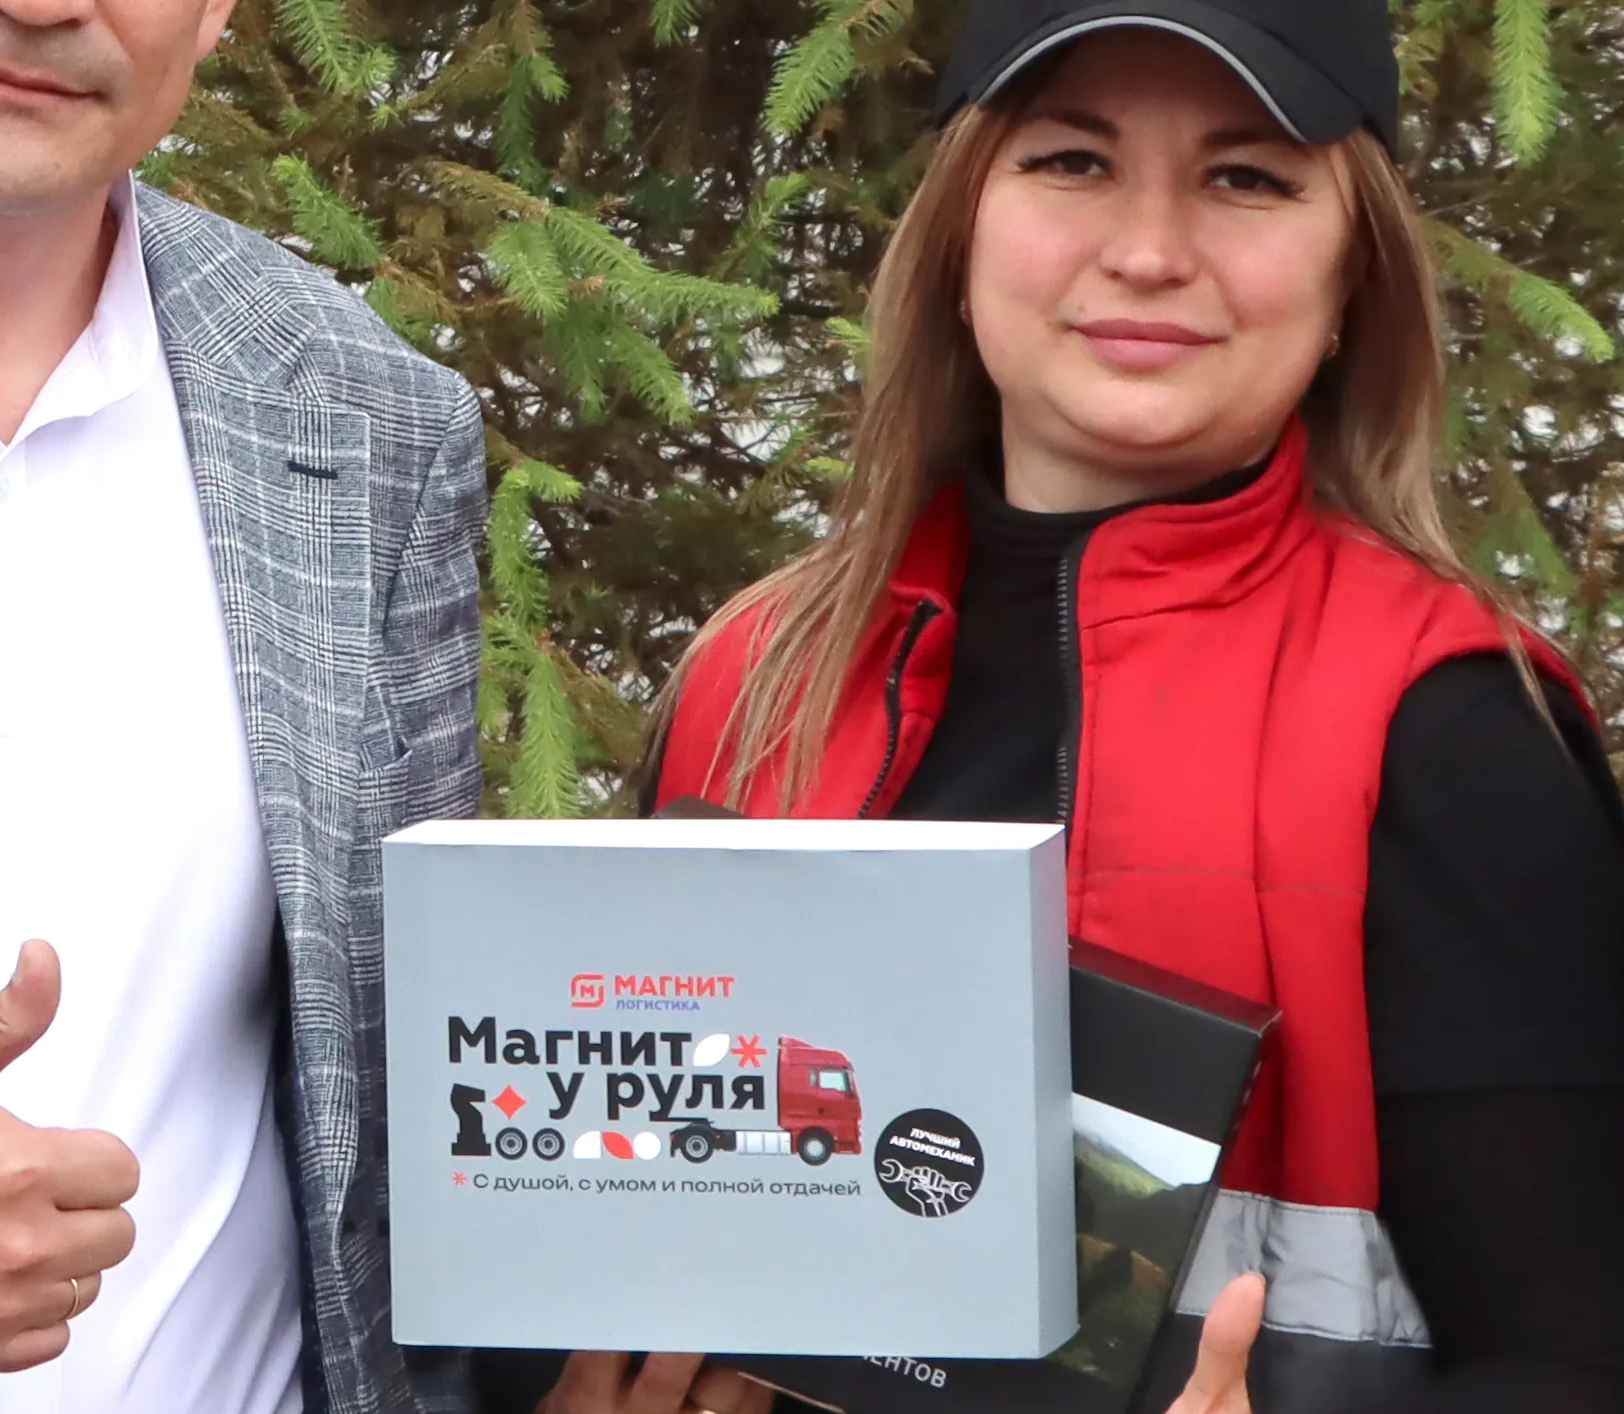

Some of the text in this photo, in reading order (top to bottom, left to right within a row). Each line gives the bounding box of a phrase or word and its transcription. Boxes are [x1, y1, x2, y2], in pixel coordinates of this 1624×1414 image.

[613, 974, 736, 998] МАГНИТ
[615, 999, 700, 1011] ЛОГИСТИКА
[448, 1015, 692, 1067] Магнит
[546, 1071, 765, 1122] у руля
[910, 1127, 961, 1149] ЛУЧШИЙ
[889, 1135, 975, 1167] АВТОМЕХАНИК
[473, 1173, 861, 1196] С душой, с умом и полной отдачей
